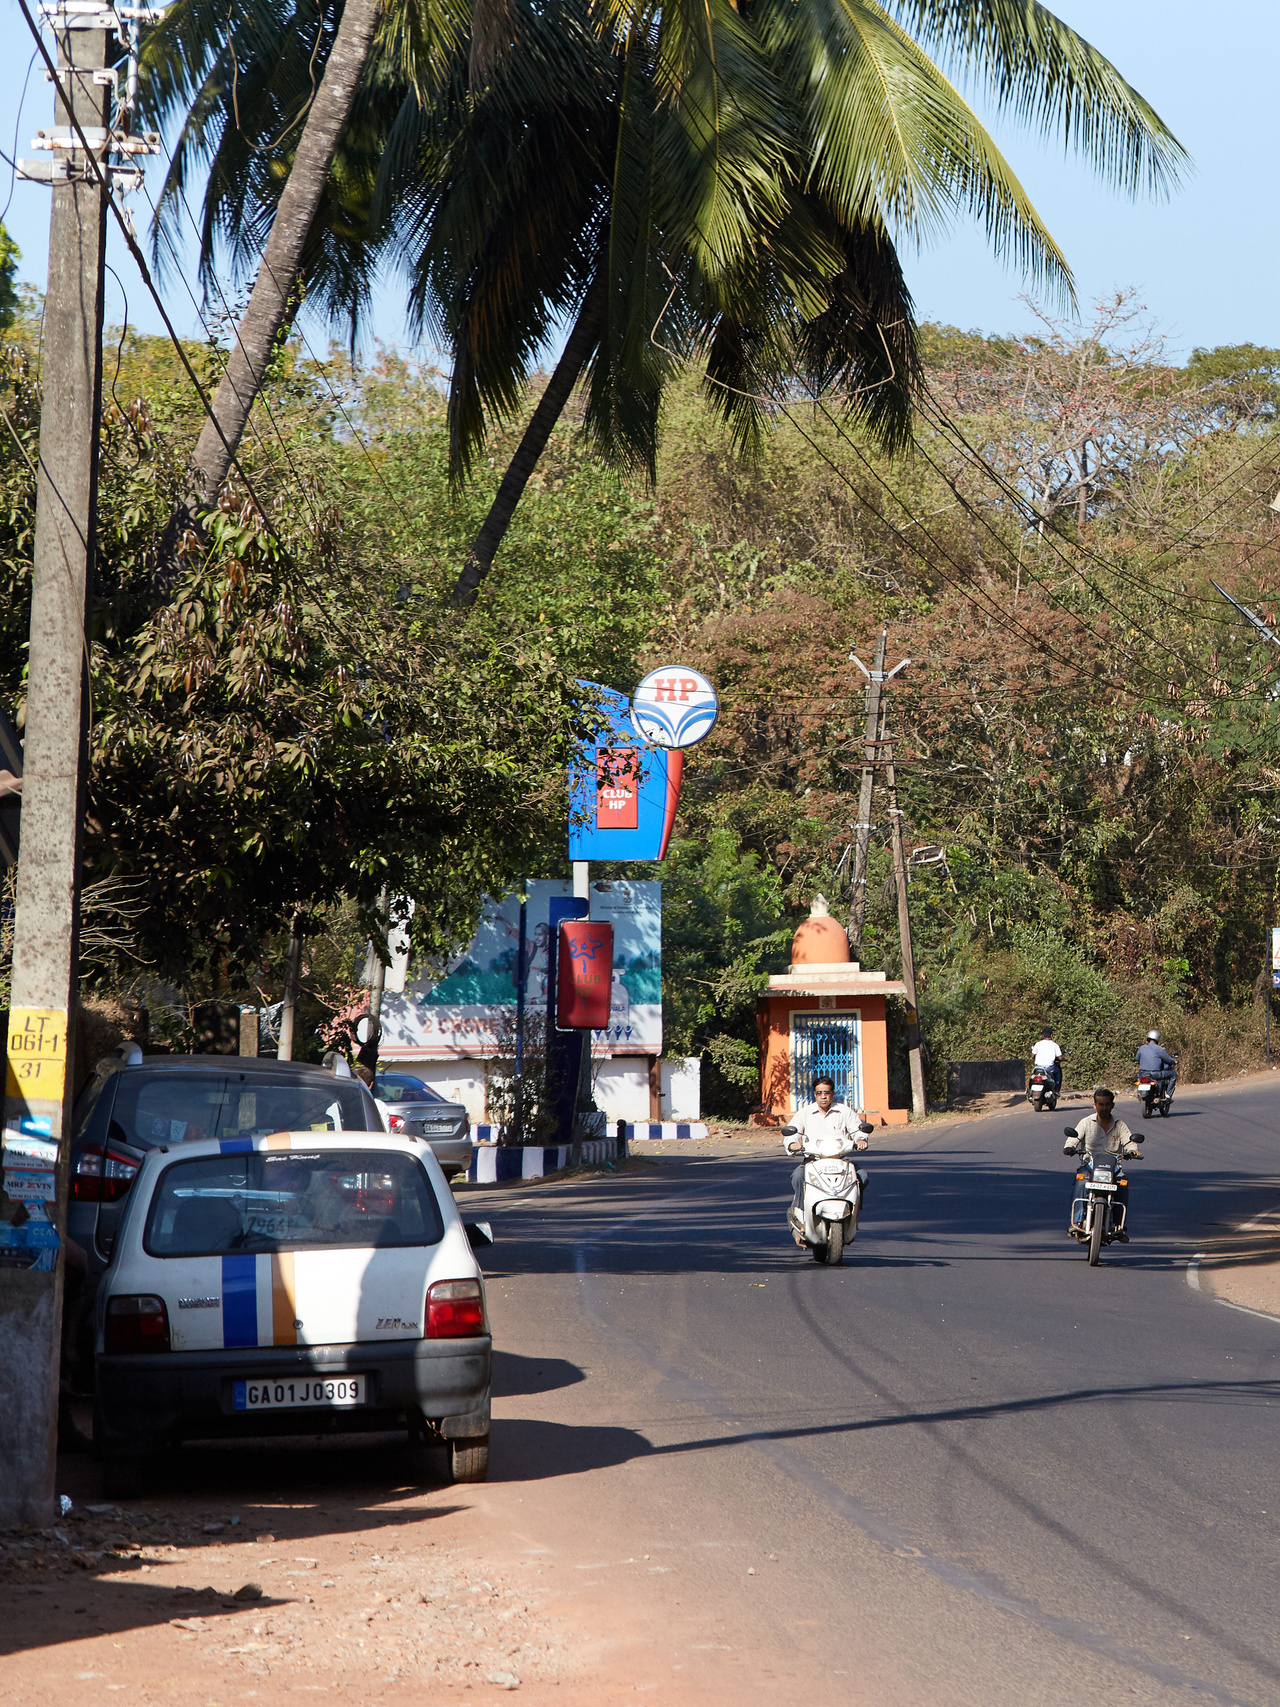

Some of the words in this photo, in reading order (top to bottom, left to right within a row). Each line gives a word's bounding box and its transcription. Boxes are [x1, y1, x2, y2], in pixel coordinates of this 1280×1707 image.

[654, 678, 698, 701] HP
[602, 789, 633, 799] CLUB
[608, 800, 626, 810] HP
[569, 974, 602, 985] CLUB
[575, 987, 594, 997] HP
[25, 1016, 50, 1033] LT
[422, 1018, 433, 1034] 2
[11, 1034, 58, 1052] 061-1
[19, 1062, 41, 1079] 31
[375, 1316, 402, 1330] ZEN
[248, 1381, 359, 1405] GA01J0309
